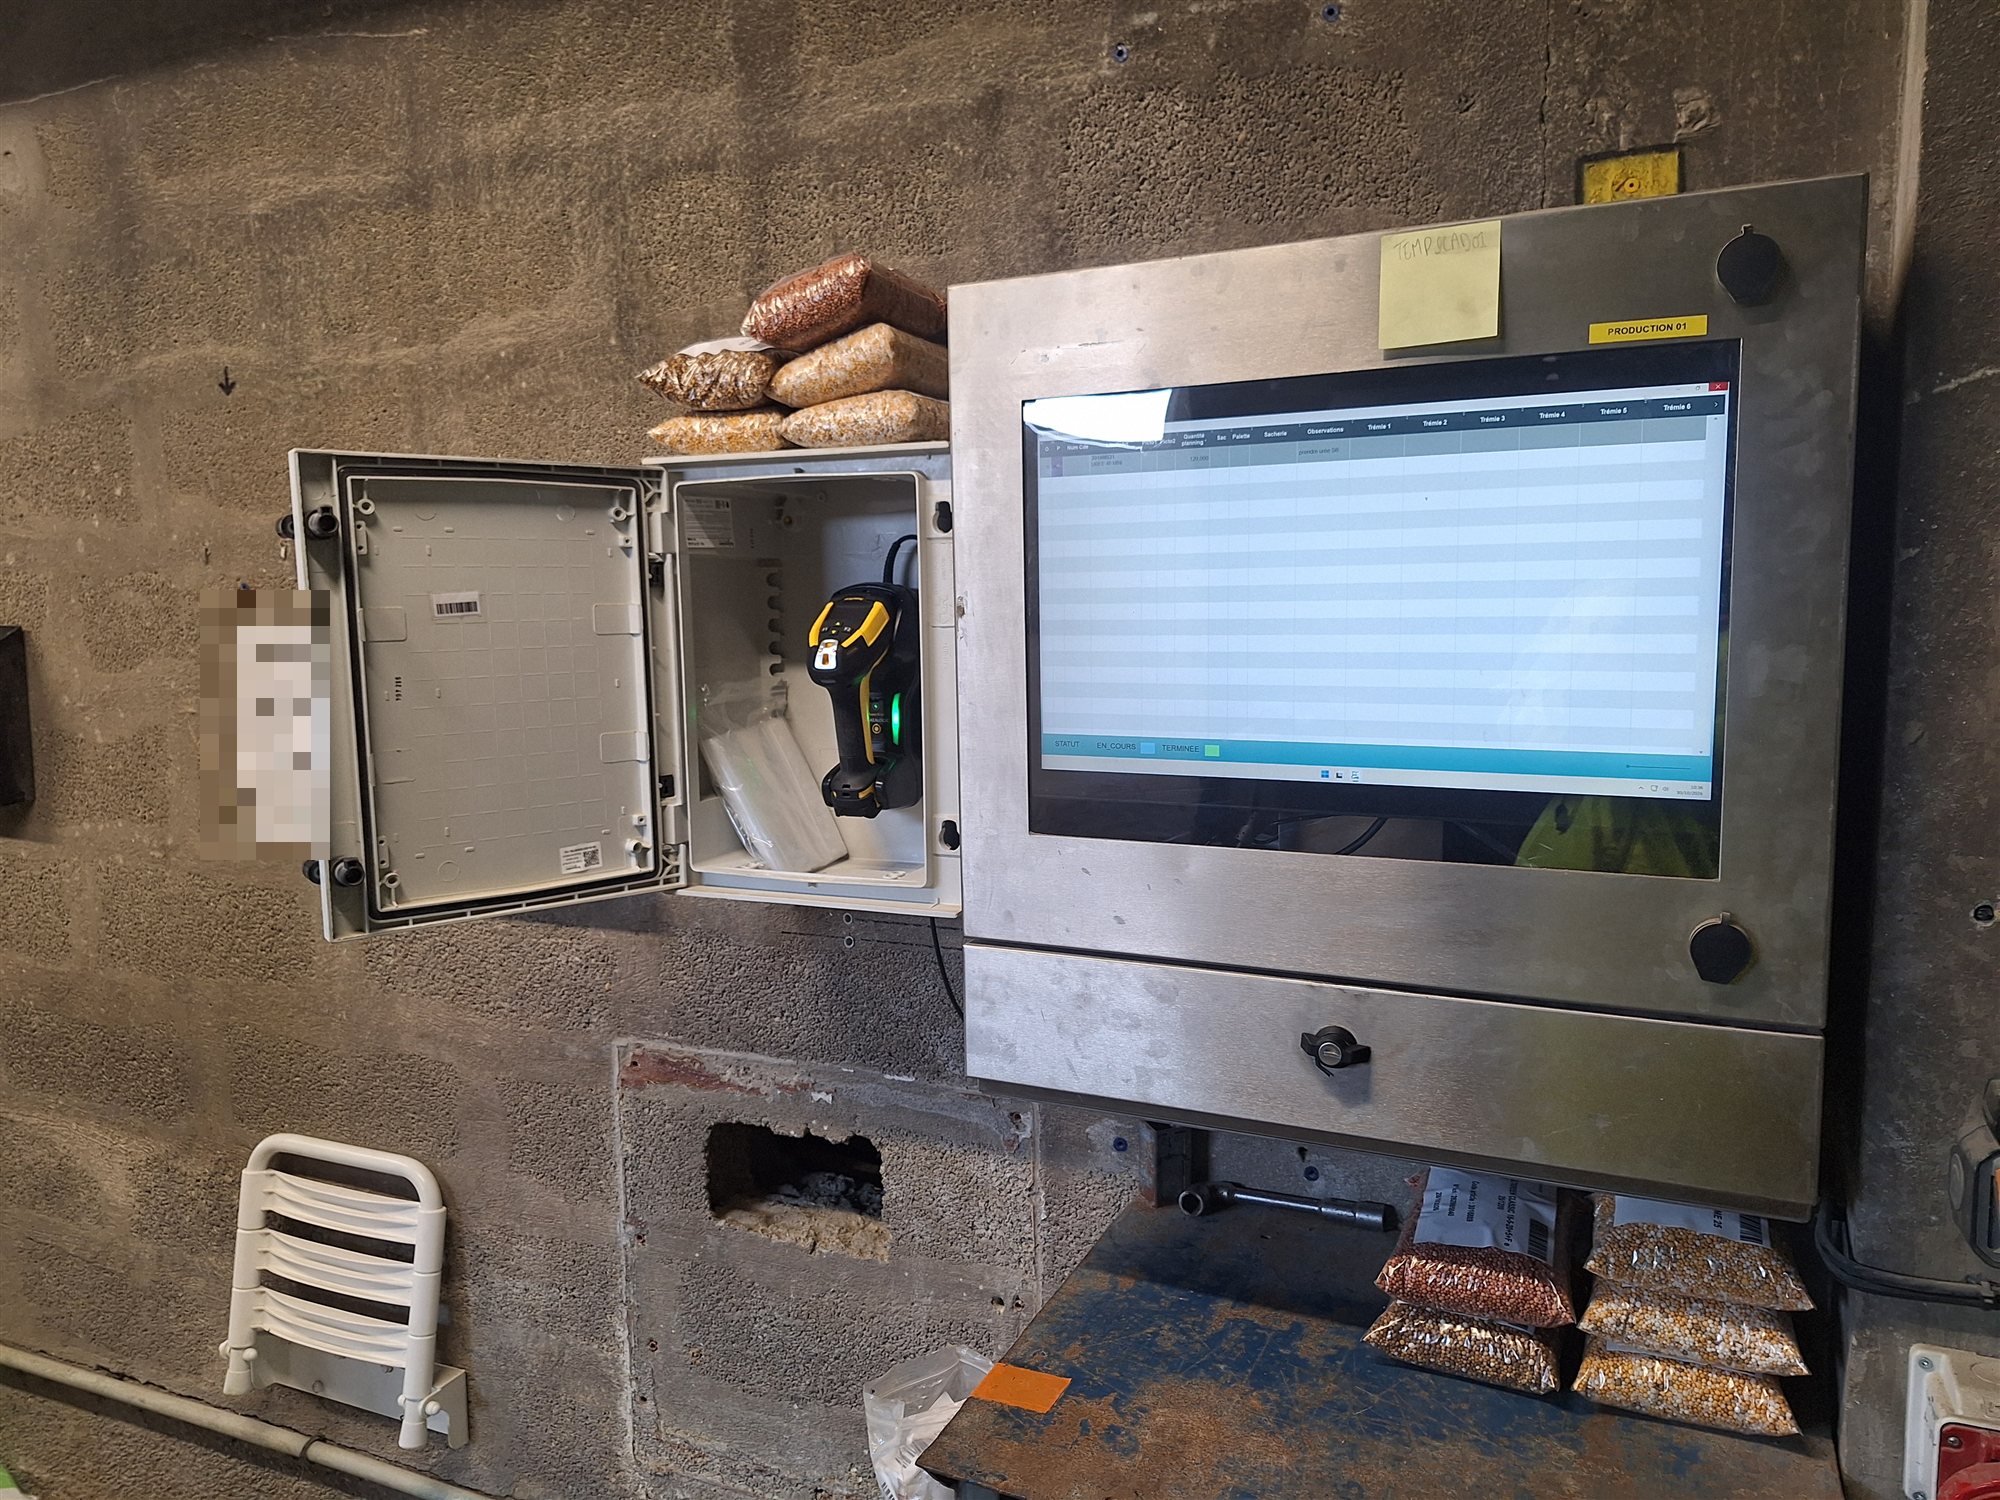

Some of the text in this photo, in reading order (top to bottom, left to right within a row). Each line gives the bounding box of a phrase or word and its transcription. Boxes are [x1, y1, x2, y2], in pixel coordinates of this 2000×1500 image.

[1607, 322, 1687, 336] PRODUCTION 01
[1600, 407, 1622, 415] Trémie
[1663, 403, 1685, 411] Trémie
[1538, 410, 1566, 419] Trémie 4
[1367, 422, 1392, 431] Trémie 1
[1422, 418, 1448, 427] Trémie 2
[1263, 429, 1288, 439] Sacherie
[1306, 426, 1345, 436] Observations
[1231, 432, 1250, 440] Palette
[1054, 740, 1080, 748] STATUT
[1096, 742, 1137, 750] EN_COURS
[1713, 1219, 1722, 1229] 25
